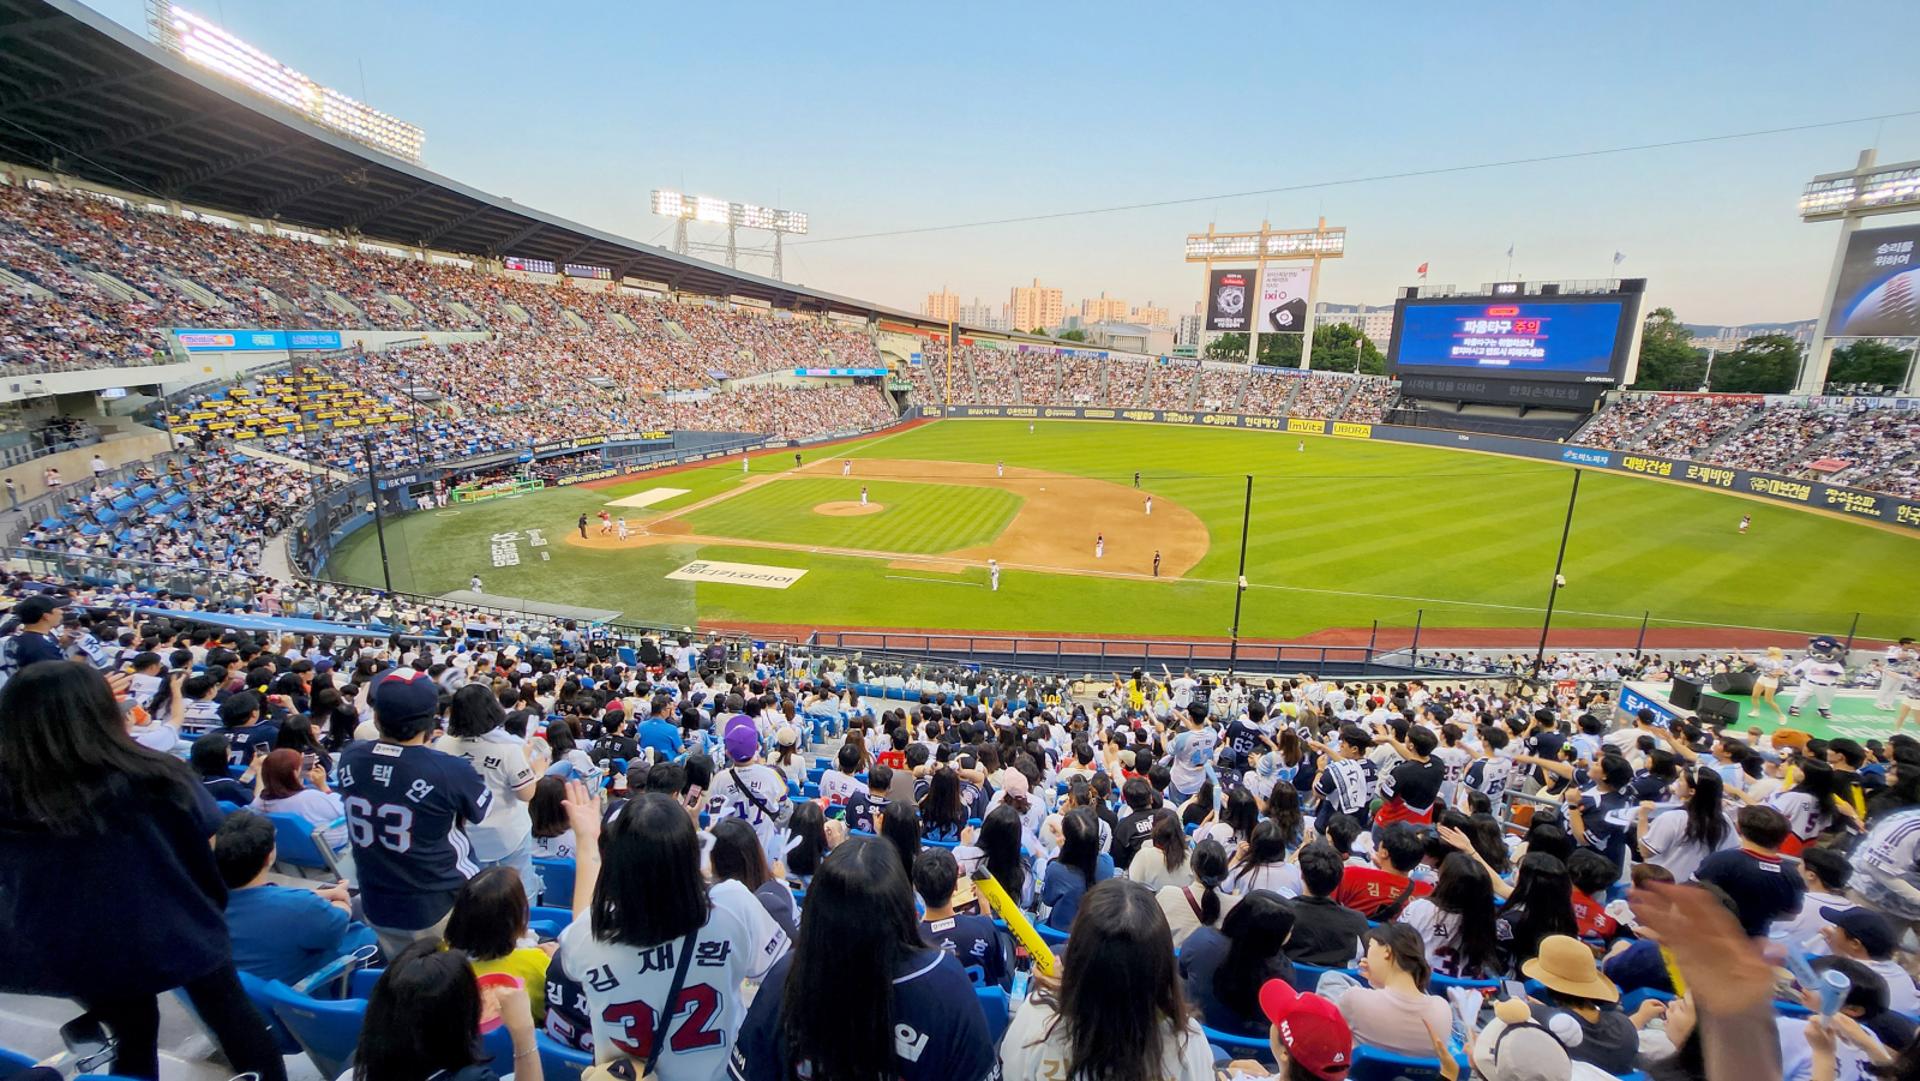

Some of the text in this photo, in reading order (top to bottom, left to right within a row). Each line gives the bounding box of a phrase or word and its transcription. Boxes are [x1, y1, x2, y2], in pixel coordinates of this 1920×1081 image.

[1877, 241, 1914, 254] 승리를
[1875, 254, 1911, 266] 위하여
[1463, 320, 1540, 335] 파울타구 주의
[1622, 456, 1673, 476] 대방건설
[1685, 465, 1735, 487] 로제비앙
[1769, 480, 1811, 501] 대보건설
[1557, 686, 1575, 696] 105
[1233, 738, 1254, 754] 63
[345, 795, 413, 854] 63
[602, 982, 727, 1059] 32
[1281, 1020, 1294, 1047] KIA
